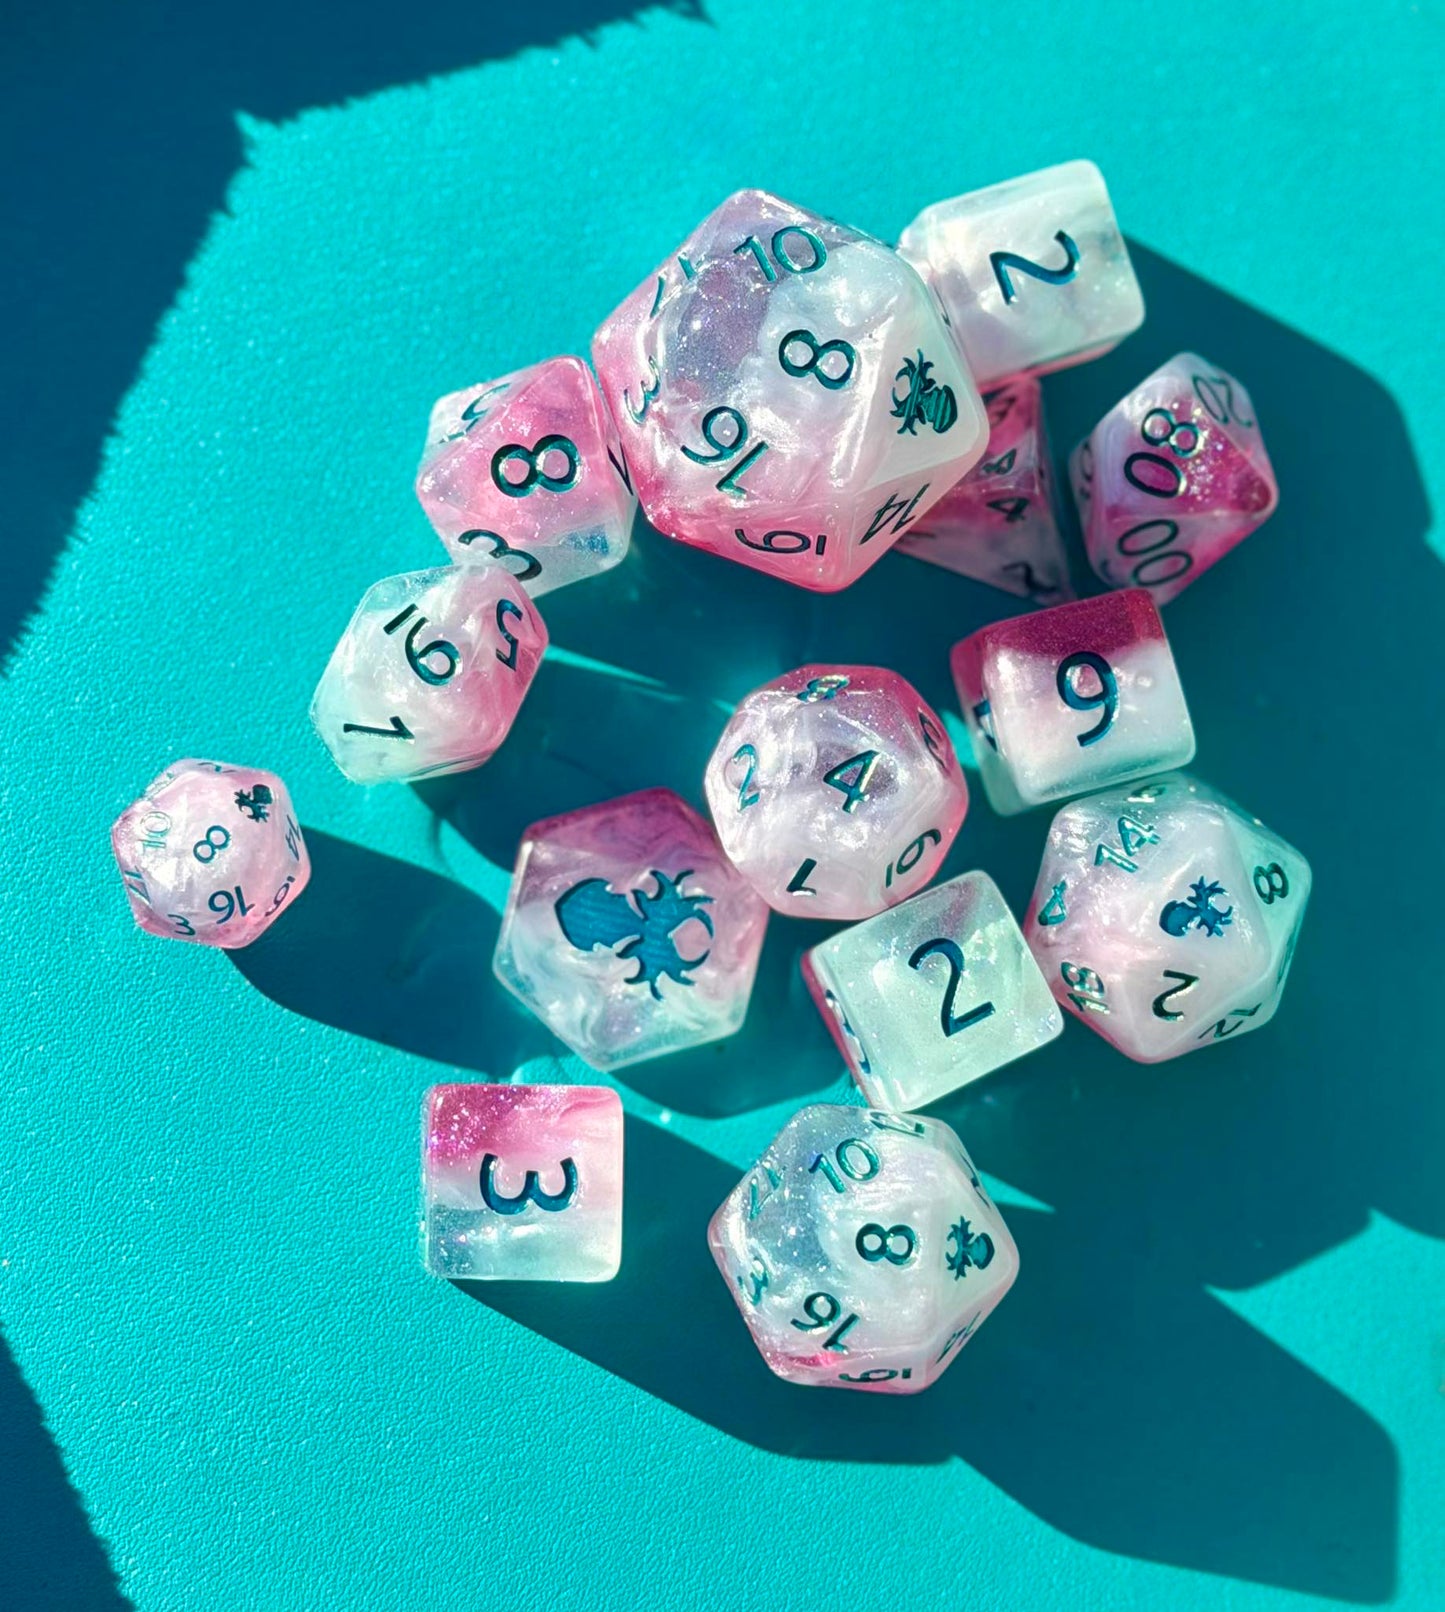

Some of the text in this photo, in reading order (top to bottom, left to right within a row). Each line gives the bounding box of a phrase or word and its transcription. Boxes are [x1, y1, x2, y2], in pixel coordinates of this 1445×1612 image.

[733, 226, 828, 283] 10
[989, 230, 1080, 305] 2
[778, 329, 857, 390] 8
[491, 433, 583, 498] 8
[681, 406, 769, 500] 16
[1124, 408, 1205, 498] 80
[860, 483, 931, 546] 14
[458, 529, 543, 582] 3
[1117, 519, 1193, 588] 00
[495, 598, 523, 671] 5
[343, 715, 415, 743] 1
[733, 744, 761, 812] 2
[823, 750, 880, 814] 4
[193, 825, 232, 864] 8
[1095, 815, 1161, 873] 14
[208, 885, 255, 925] 16
[1038, 880, 1067, 926] 4
[1253, 862, 1290, 904] 8
[168, 914, 196, 936] 3
[908, 937, 996, 1038] 2
[1061, 962, 1110, 1015] 18
[1152, 970, 1199, 1021] 2
[479, 1153, 579, 1215] 3
[808, 1138, 882, 1194] 10
[855, 1223, 918, 1267] 8
[791, 1292, 860, 1354] 16
